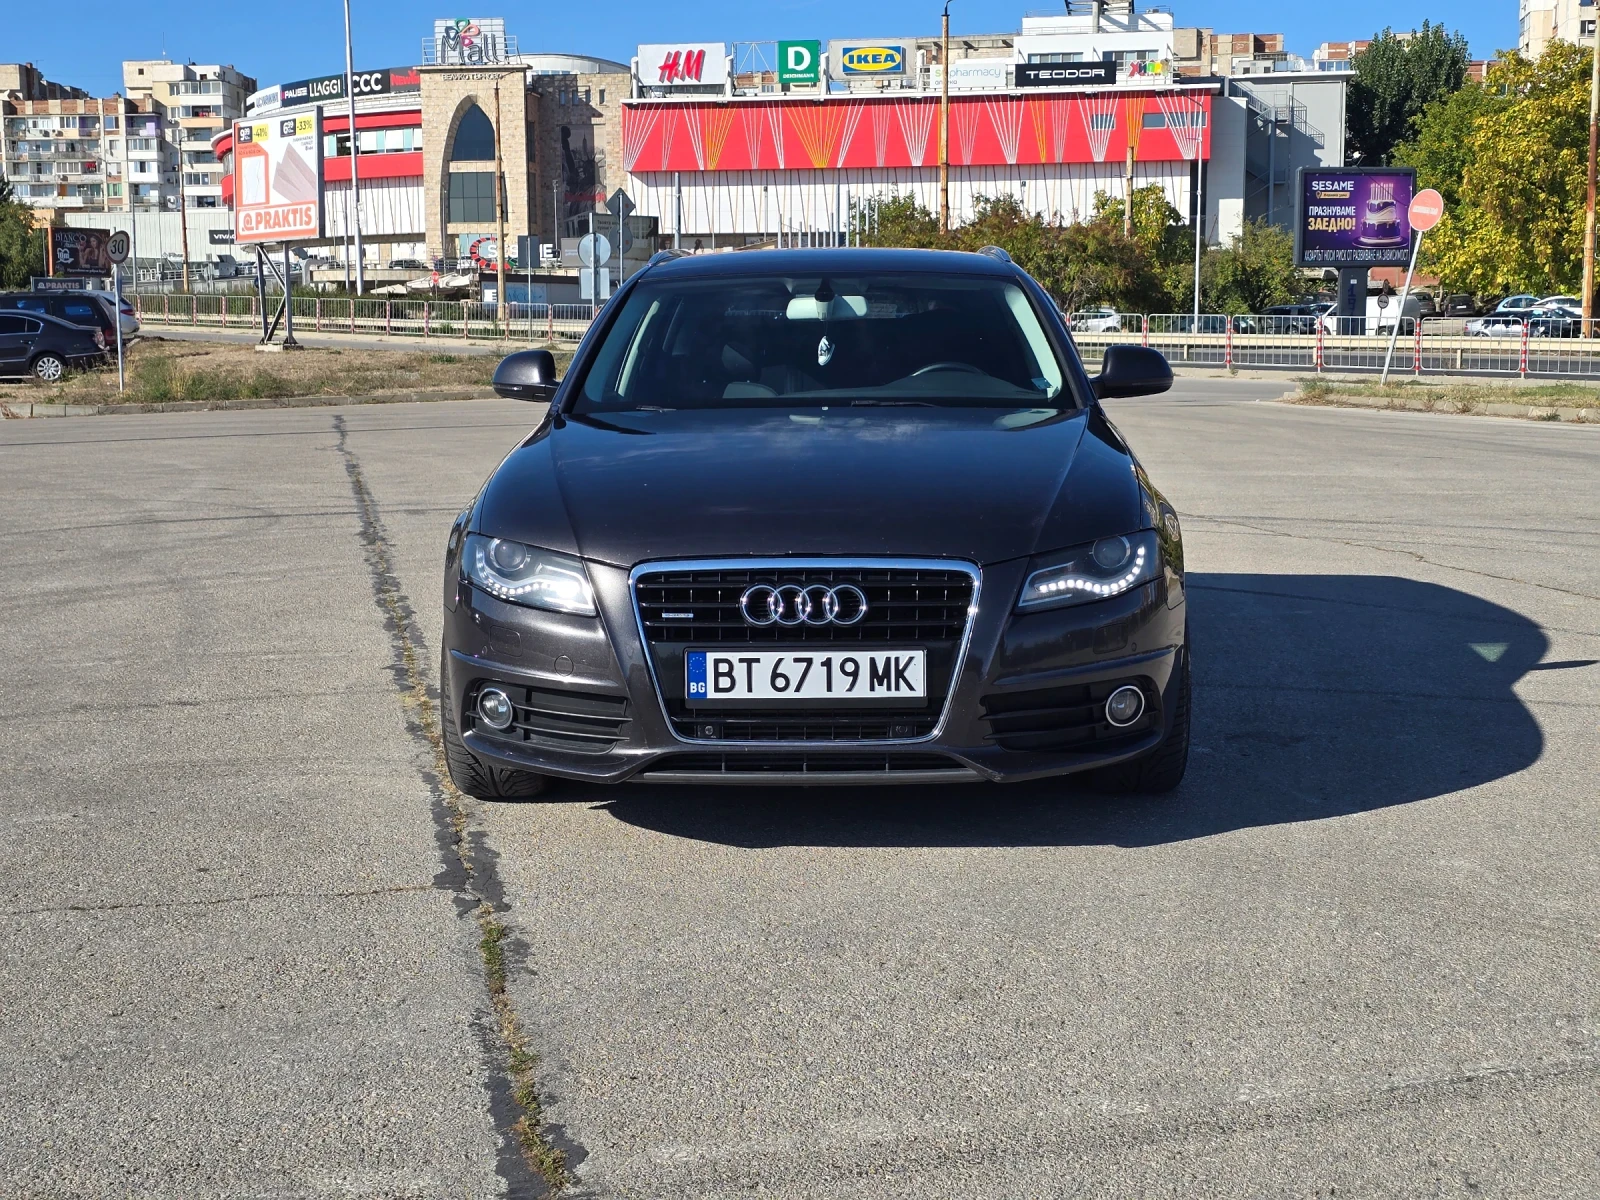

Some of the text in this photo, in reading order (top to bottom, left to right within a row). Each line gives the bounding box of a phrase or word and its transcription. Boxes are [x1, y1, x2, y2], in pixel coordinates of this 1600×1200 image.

[441, 34, 504, 64] Mall
[787, 47, 811, 70] D
[848, 53, 898, 65] IKEA
[658, 49, 705, 83] H&M
[935, 68, 1001, 78] spharmacy
[1025, 68, 1105, 79] TEODOR
[353, 73, 382, 93] CCC
[285, 87, 307, 99] PAUSE
[297, 120, 312, 131] -33%
[1312, 181, 1354, 190] SESAME
[1309, 206, 1356, 216] ПРАЗНУВАМЕ
[1308, 218, 1356, 232] ЗАЕДНО!
[110, 240, 125, 254] 30
[690, 656, 916, 693] BG BT 6719 MK
